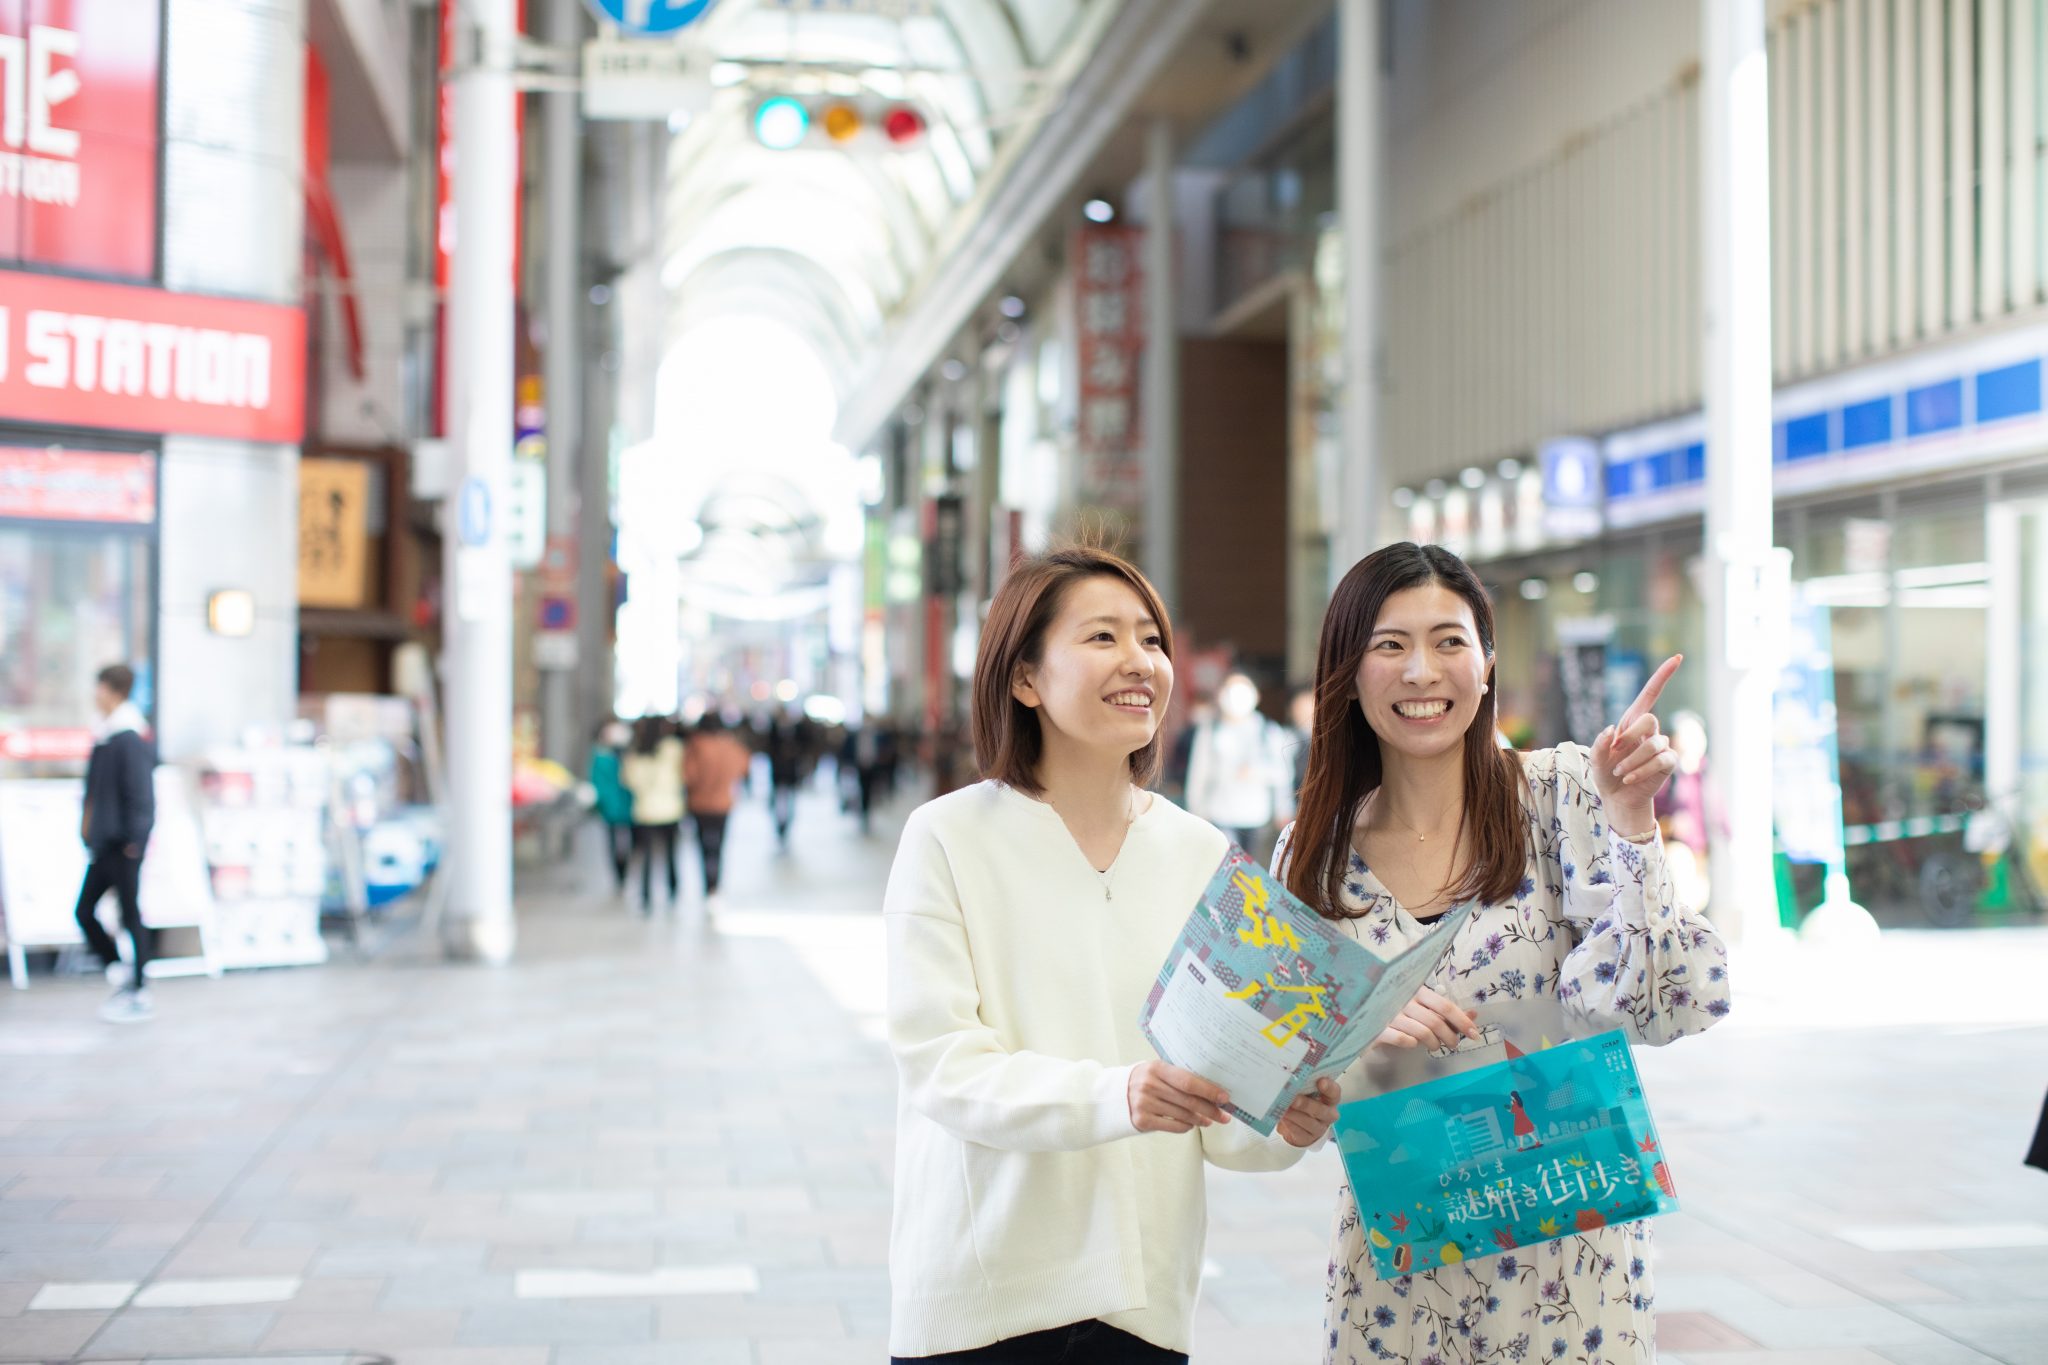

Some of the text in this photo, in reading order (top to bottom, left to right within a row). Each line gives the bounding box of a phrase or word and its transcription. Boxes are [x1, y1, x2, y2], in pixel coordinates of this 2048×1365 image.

[25, 309, 270, 409] STATION
[1439, 1158, 1505, 1187] ひろしま
[1439, 1153, 1642, 1225] 謎解き街歩き
